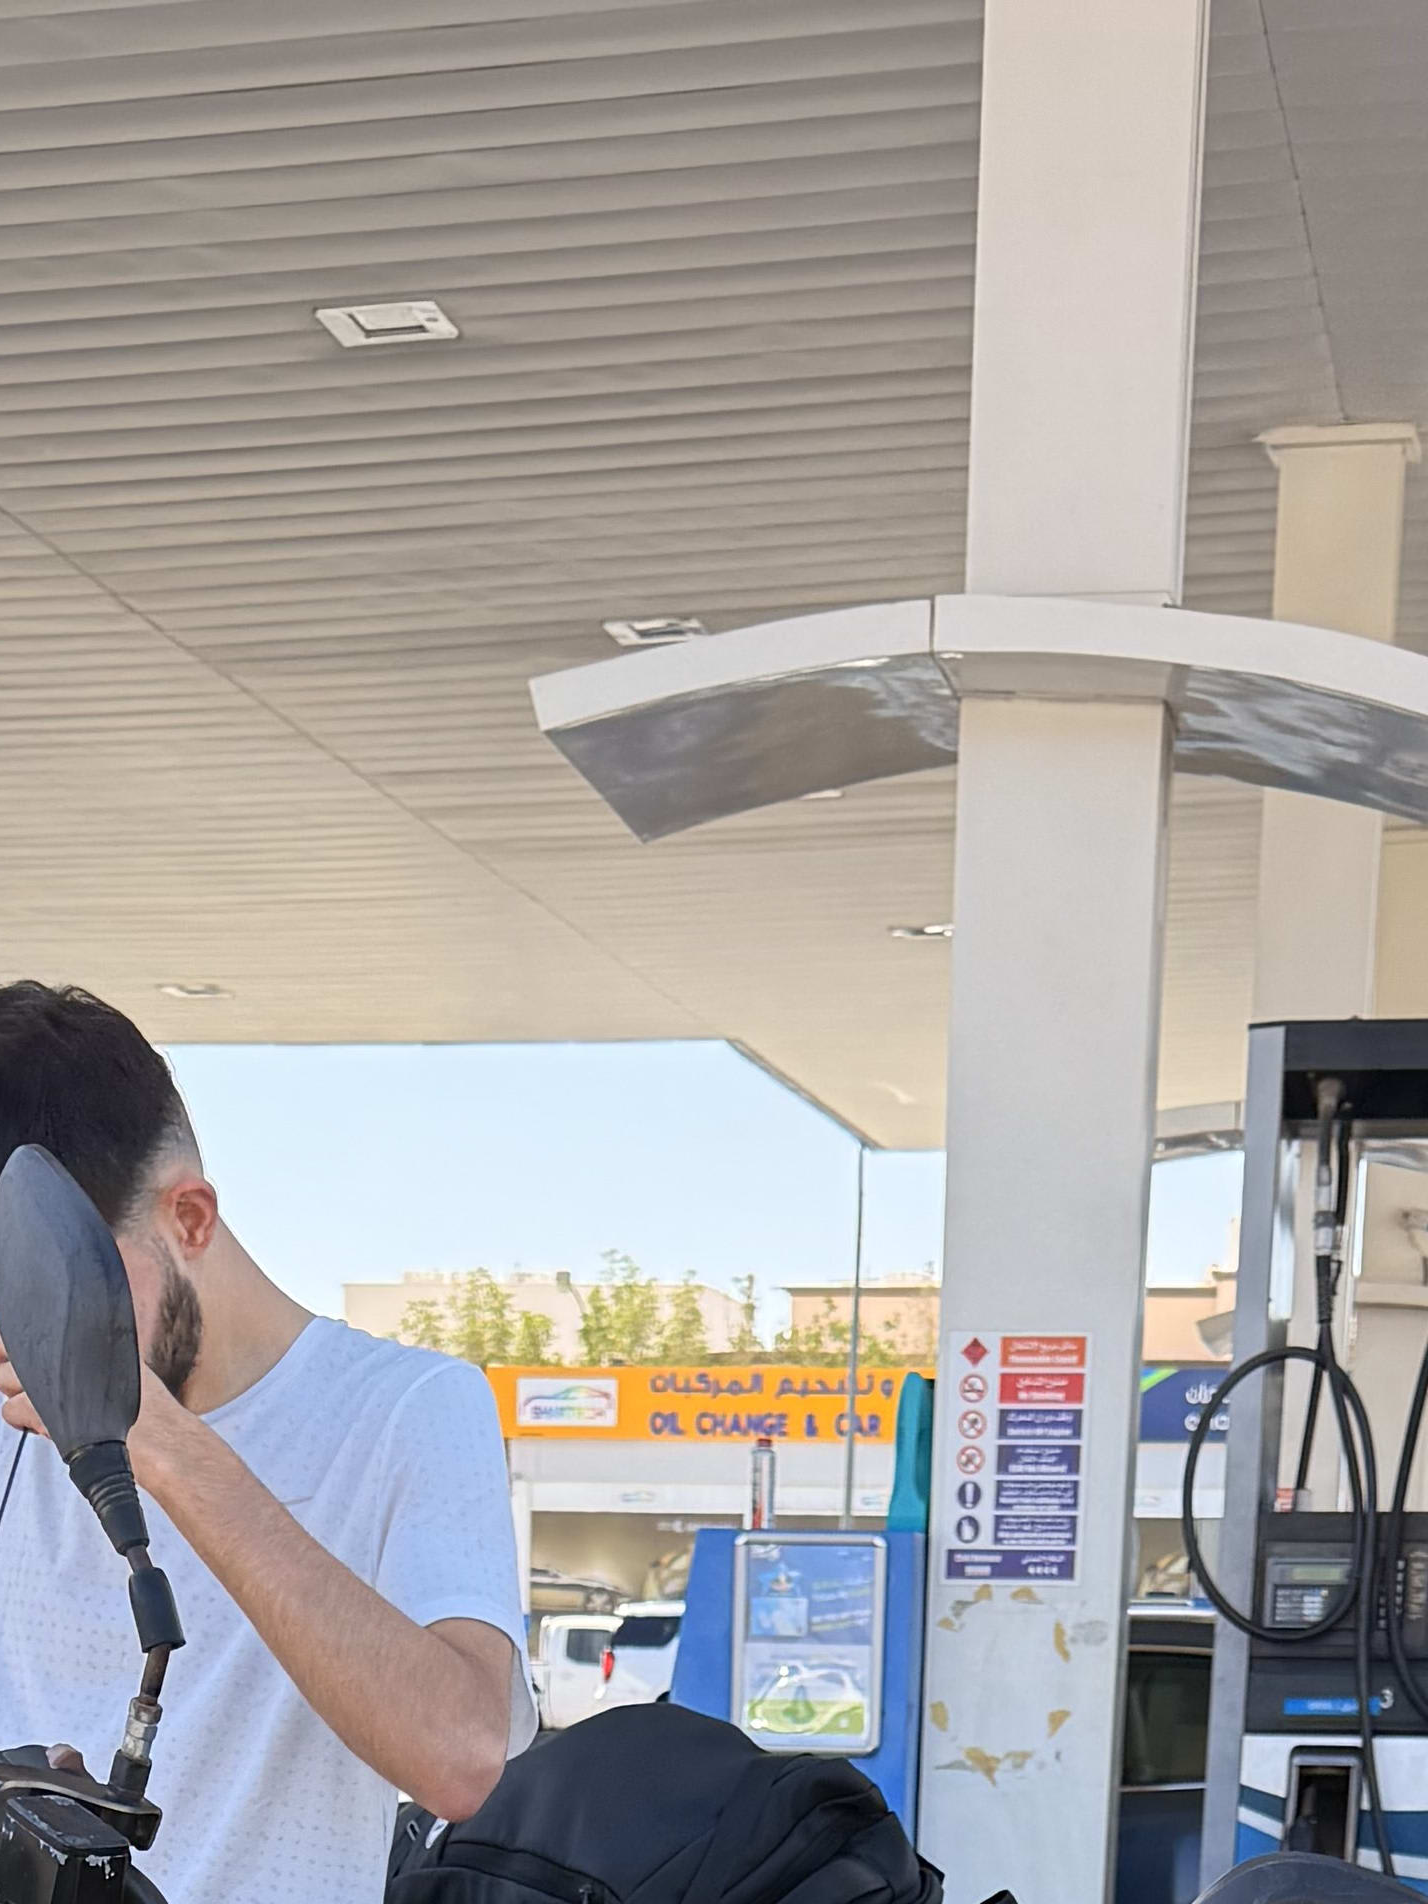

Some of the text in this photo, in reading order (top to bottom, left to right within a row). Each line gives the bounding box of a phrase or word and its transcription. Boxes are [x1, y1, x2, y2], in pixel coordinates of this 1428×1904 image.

[650, 1411, 686, 1435] OIL
[696, 1411, 789, 1438] CHANGE
[835, 1412, 881, 1438] CAR
[1379, 1688, 1394, 1709] 3
